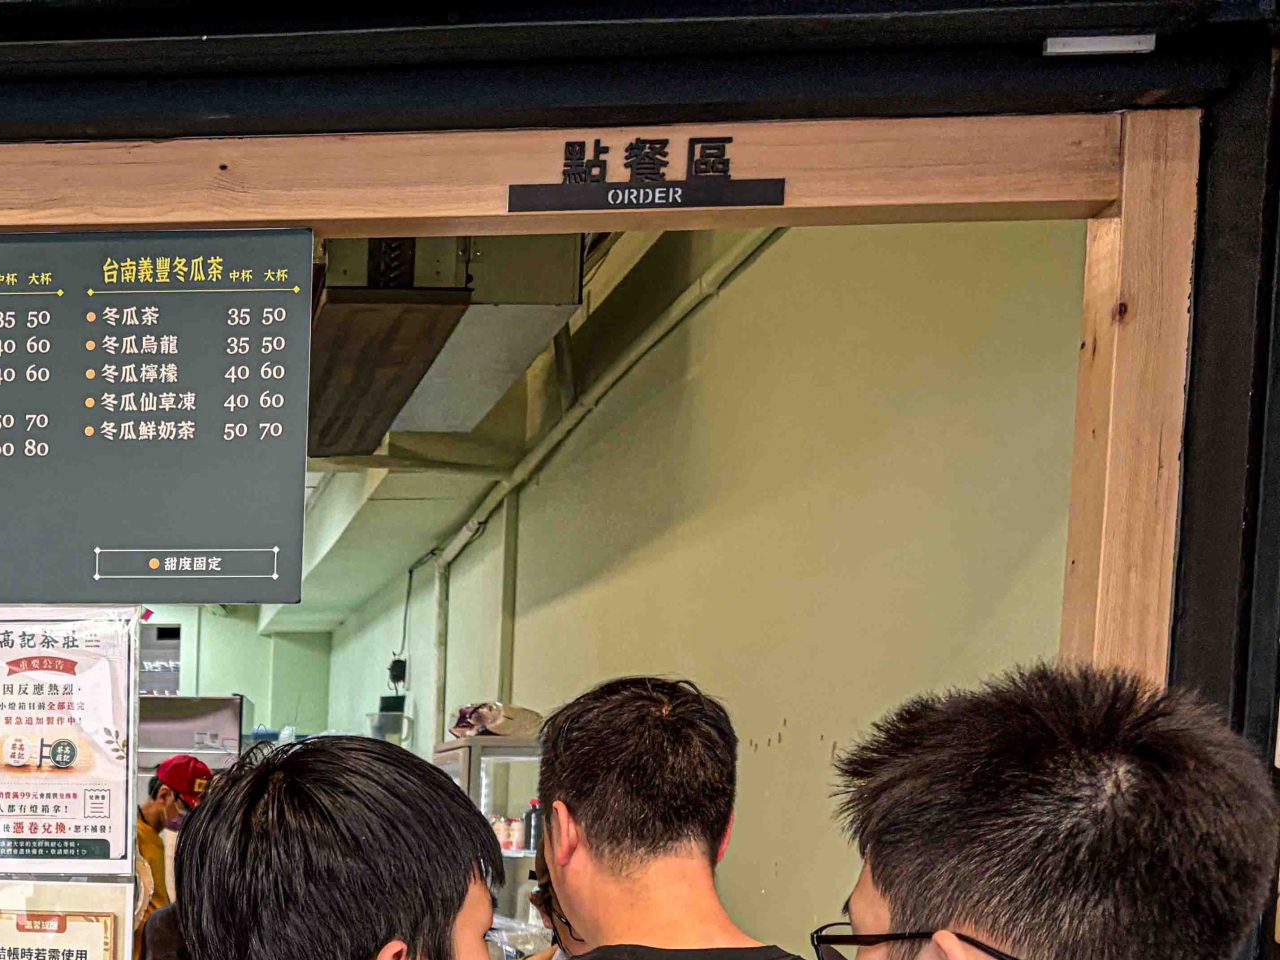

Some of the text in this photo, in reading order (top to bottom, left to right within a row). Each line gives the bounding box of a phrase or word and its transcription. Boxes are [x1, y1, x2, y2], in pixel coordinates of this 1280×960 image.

[563, 137, 733, 184] 點餐區
[608, 188, 683, 204] ORDER
[103, 256, 223, 283] 台南義豐冬瓜茶
[27, 311, 50, 328] 50
[103, 306, 286, 326] 冬瓜茶 35 50
[27, 336, 50, 353] 60
[102, 335, 285, 354] 冬瓜烏龍 35 50
[26, 365, 49, 381] 60
[102, 362, 284, 383] 冬瓜檸檬 40 60
[101, 391, 284, 411] 冬瓜仙草凍 40 60
[26, 414, 48, 431] 70
[101, 421, 282, 440] 冬瓜鮮奶茶 50 70
[25, 439, 48, 456] 80
[164, 557, 221, 570] 甜度固定
